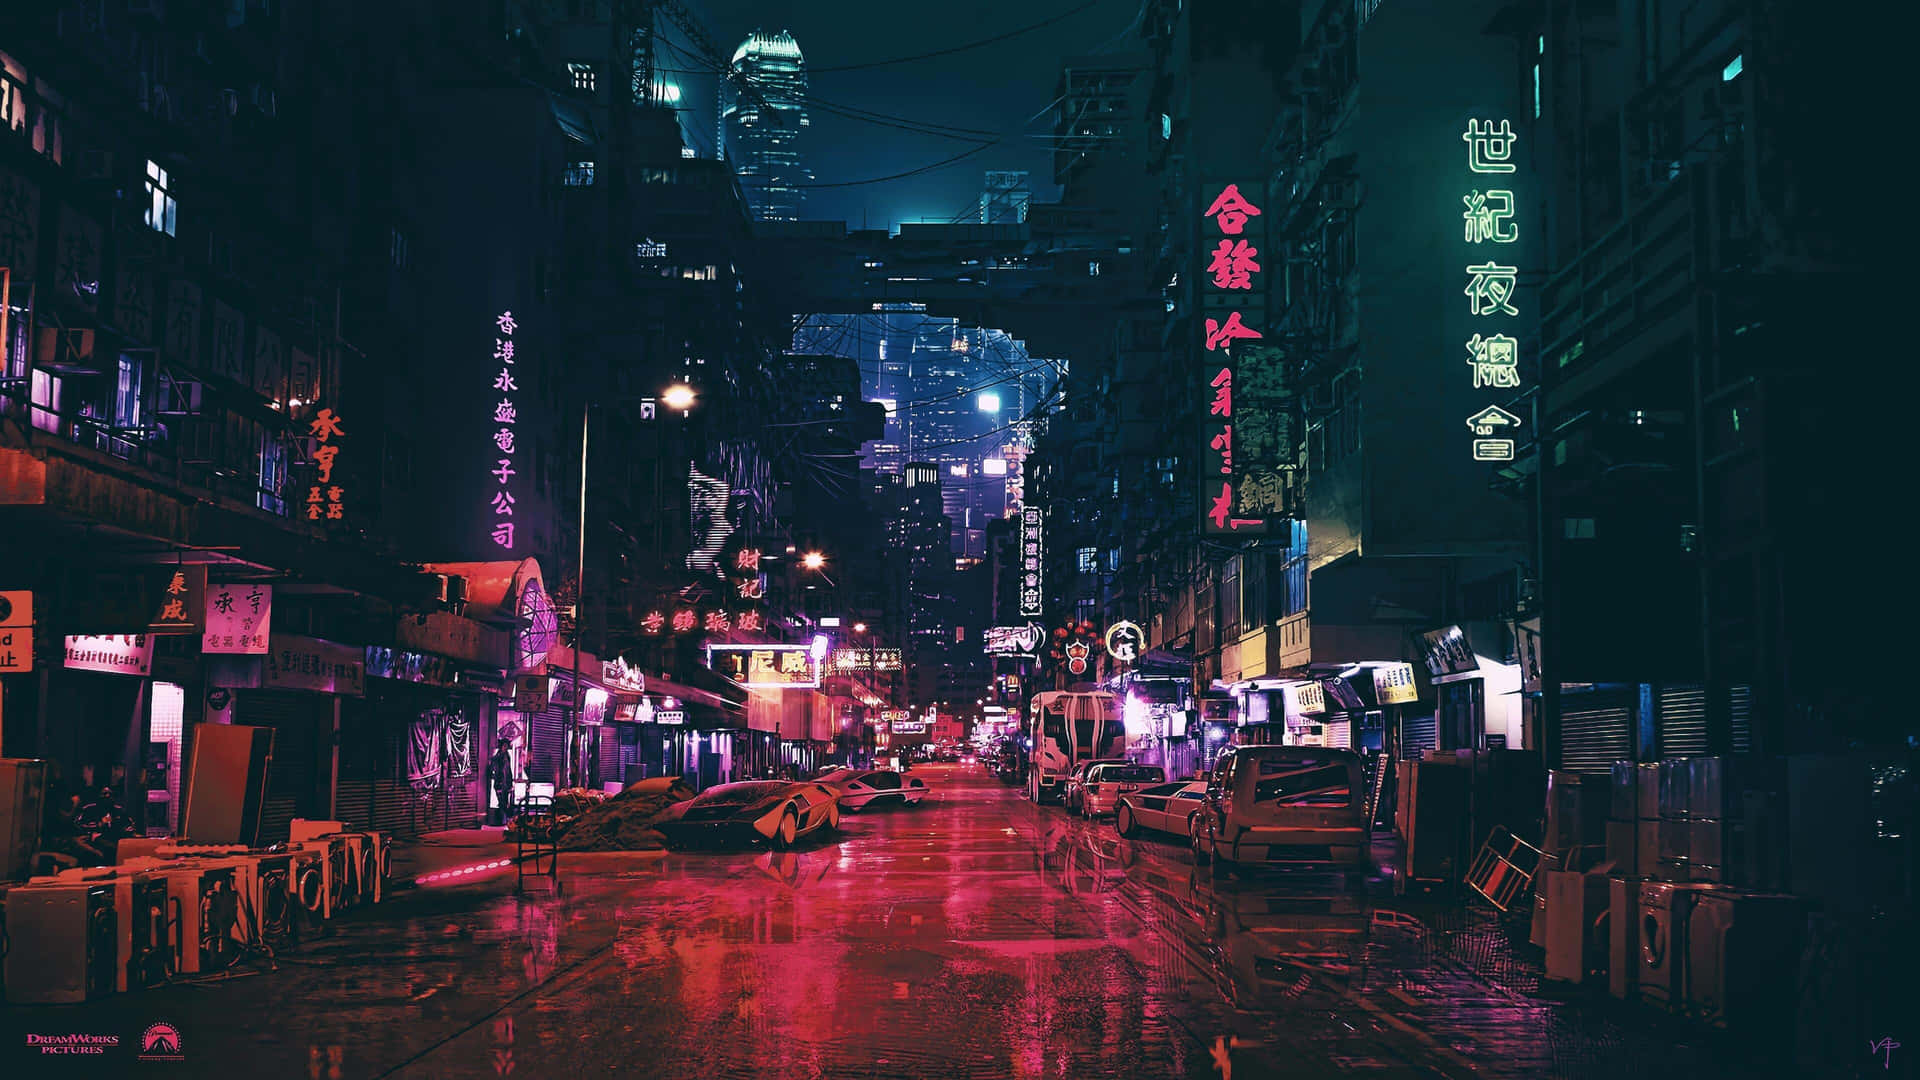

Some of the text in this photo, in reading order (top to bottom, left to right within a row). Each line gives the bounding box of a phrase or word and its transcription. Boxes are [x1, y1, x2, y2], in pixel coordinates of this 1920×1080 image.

[1462, 118, 1522, 461] 世紀夜總會
[490, 311, 518, 548] 香港永盛電子公司
[737, 548, 763, 599] 財記
